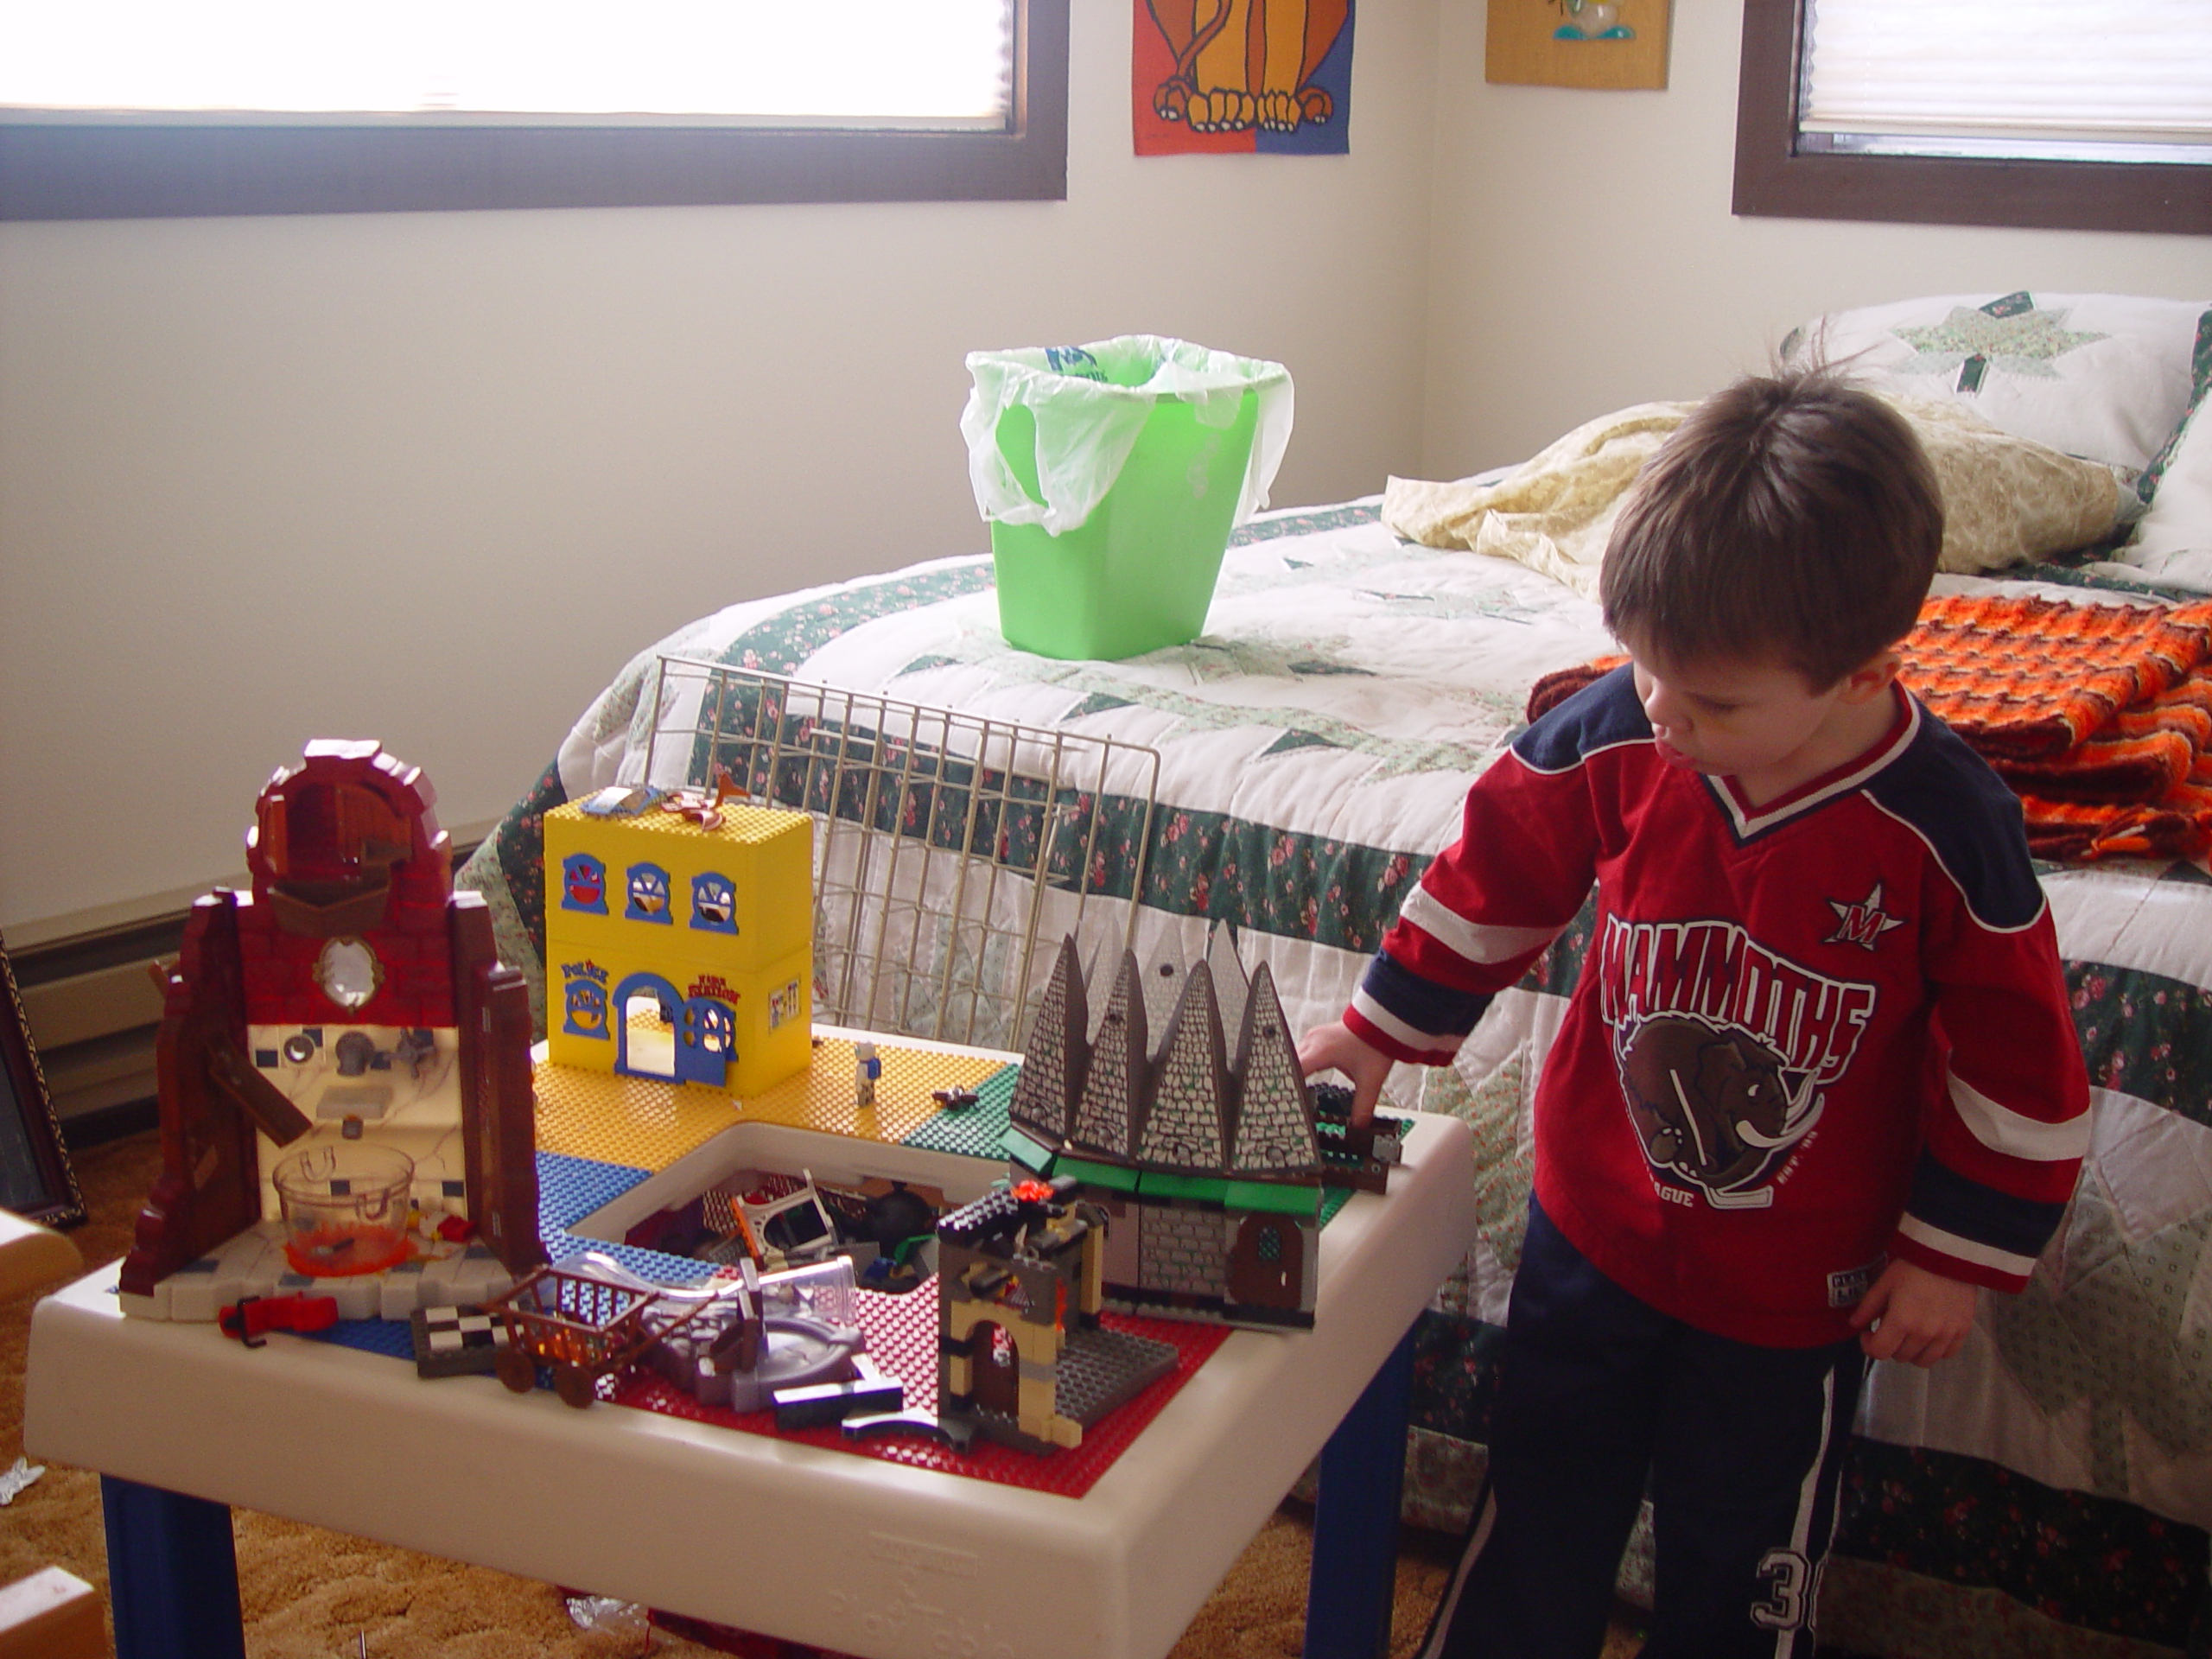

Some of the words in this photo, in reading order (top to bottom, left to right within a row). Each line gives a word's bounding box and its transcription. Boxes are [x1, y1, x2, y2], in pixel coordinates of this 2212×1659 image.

[1837, 905, 1887, 944] M
[1600, 913, 1876, 1085] MAMMOTHS
[1751, 1548, 1816, 1631] 3
